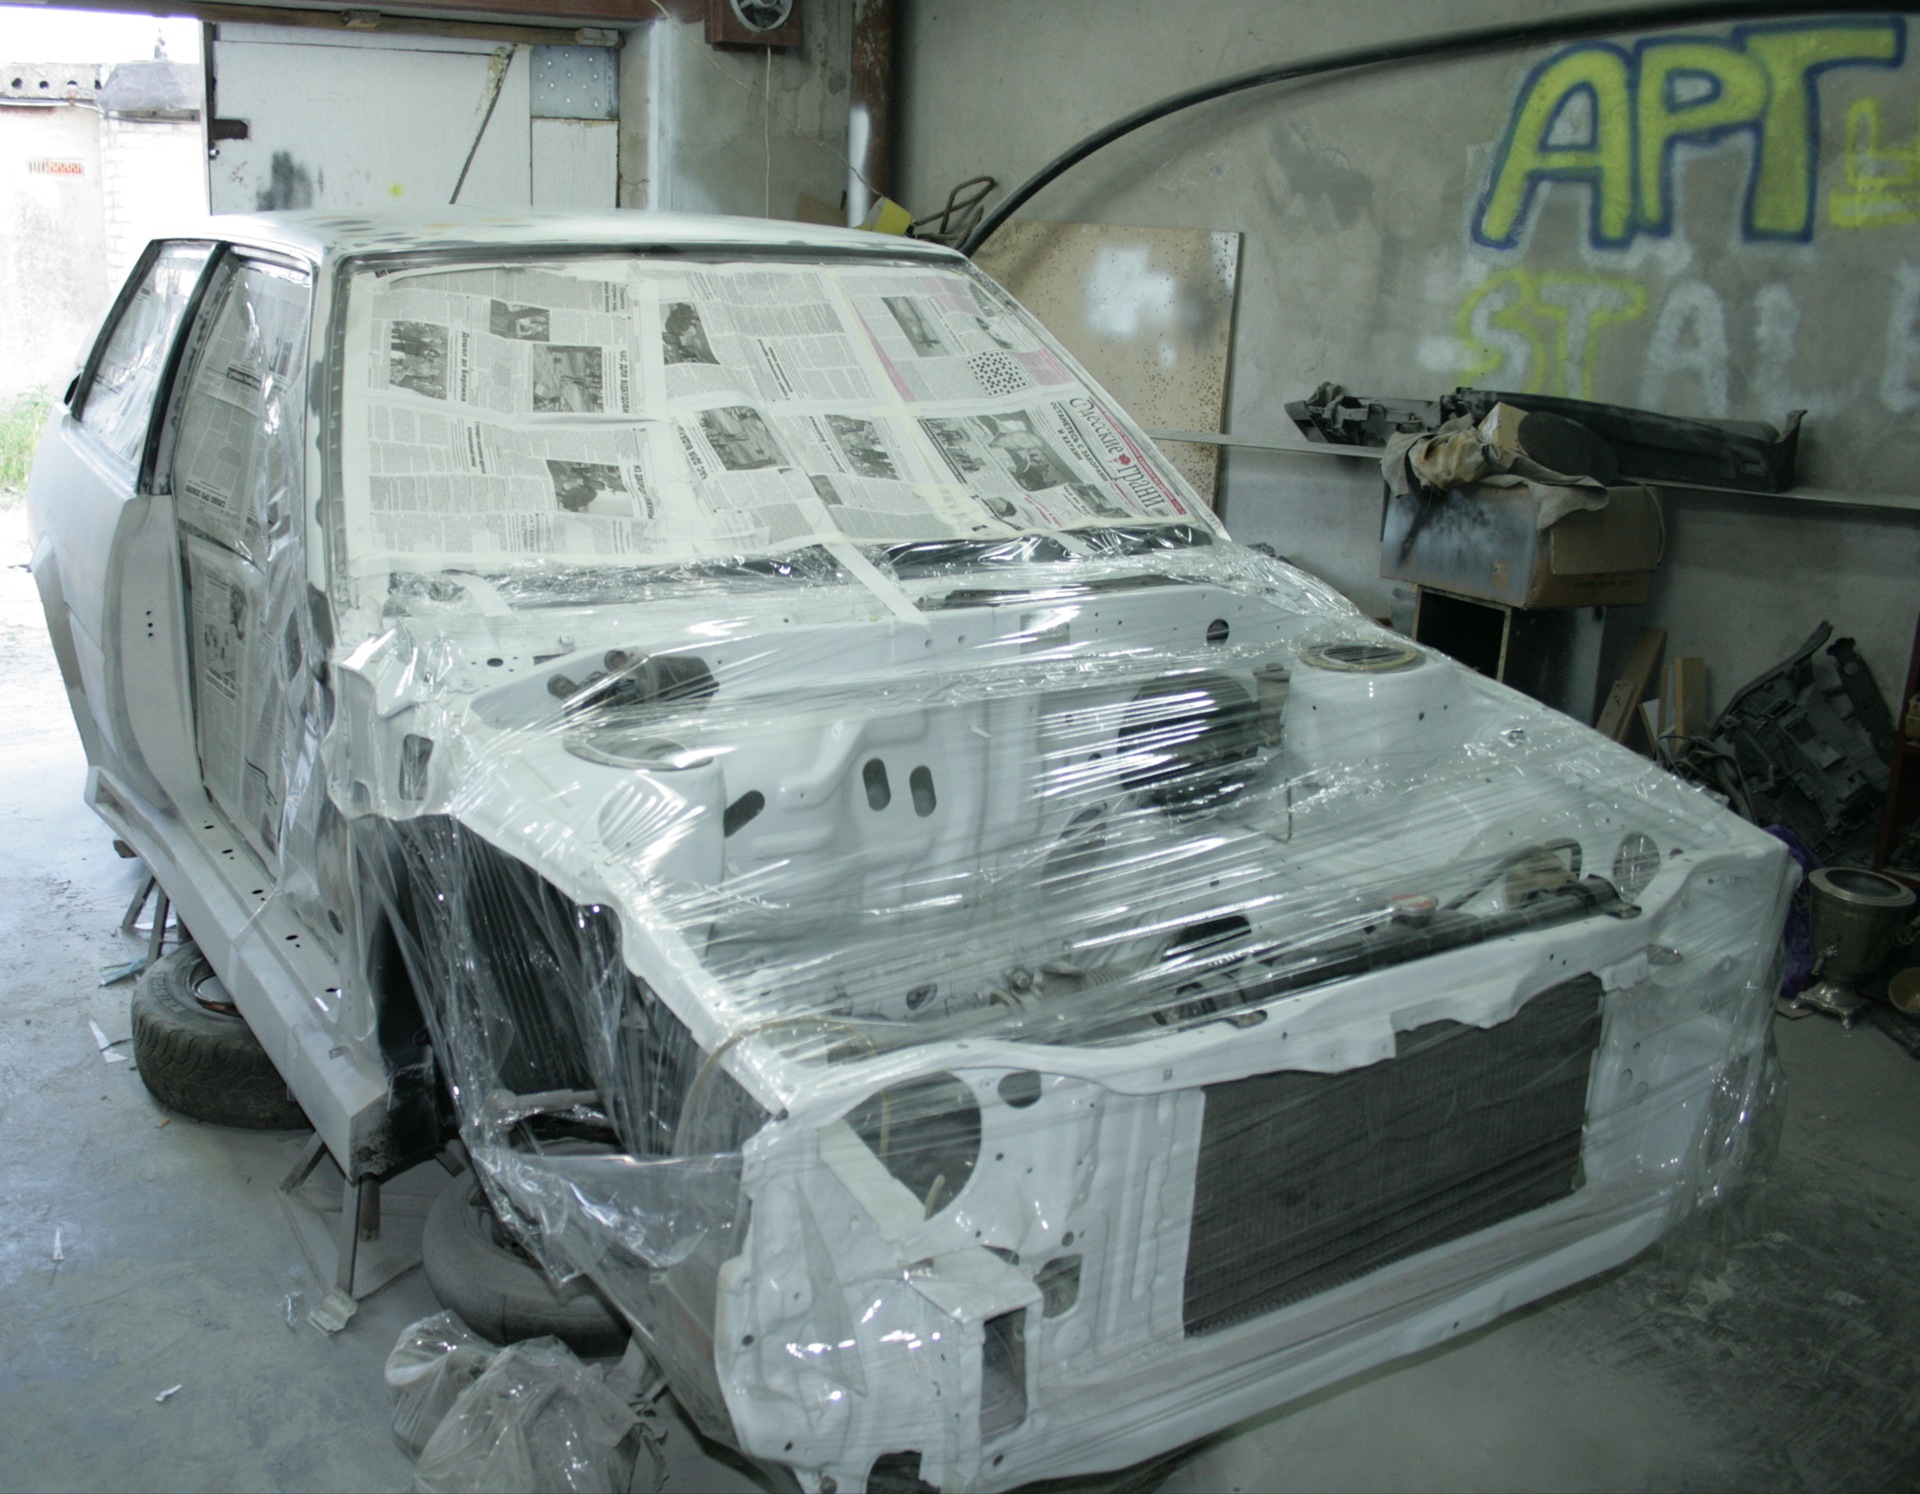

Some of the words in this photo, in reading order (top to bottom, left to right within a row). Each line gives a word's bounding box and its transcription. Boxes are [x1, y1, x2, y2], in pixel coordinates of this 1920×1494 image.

[1050, 401, 1080, 444] ОСТАНЕТЕСЬ
[1080, 450, 1109, 482] ЗАБОРАМИ
[1061, 436, 1083, 461] ХАТАМИ
